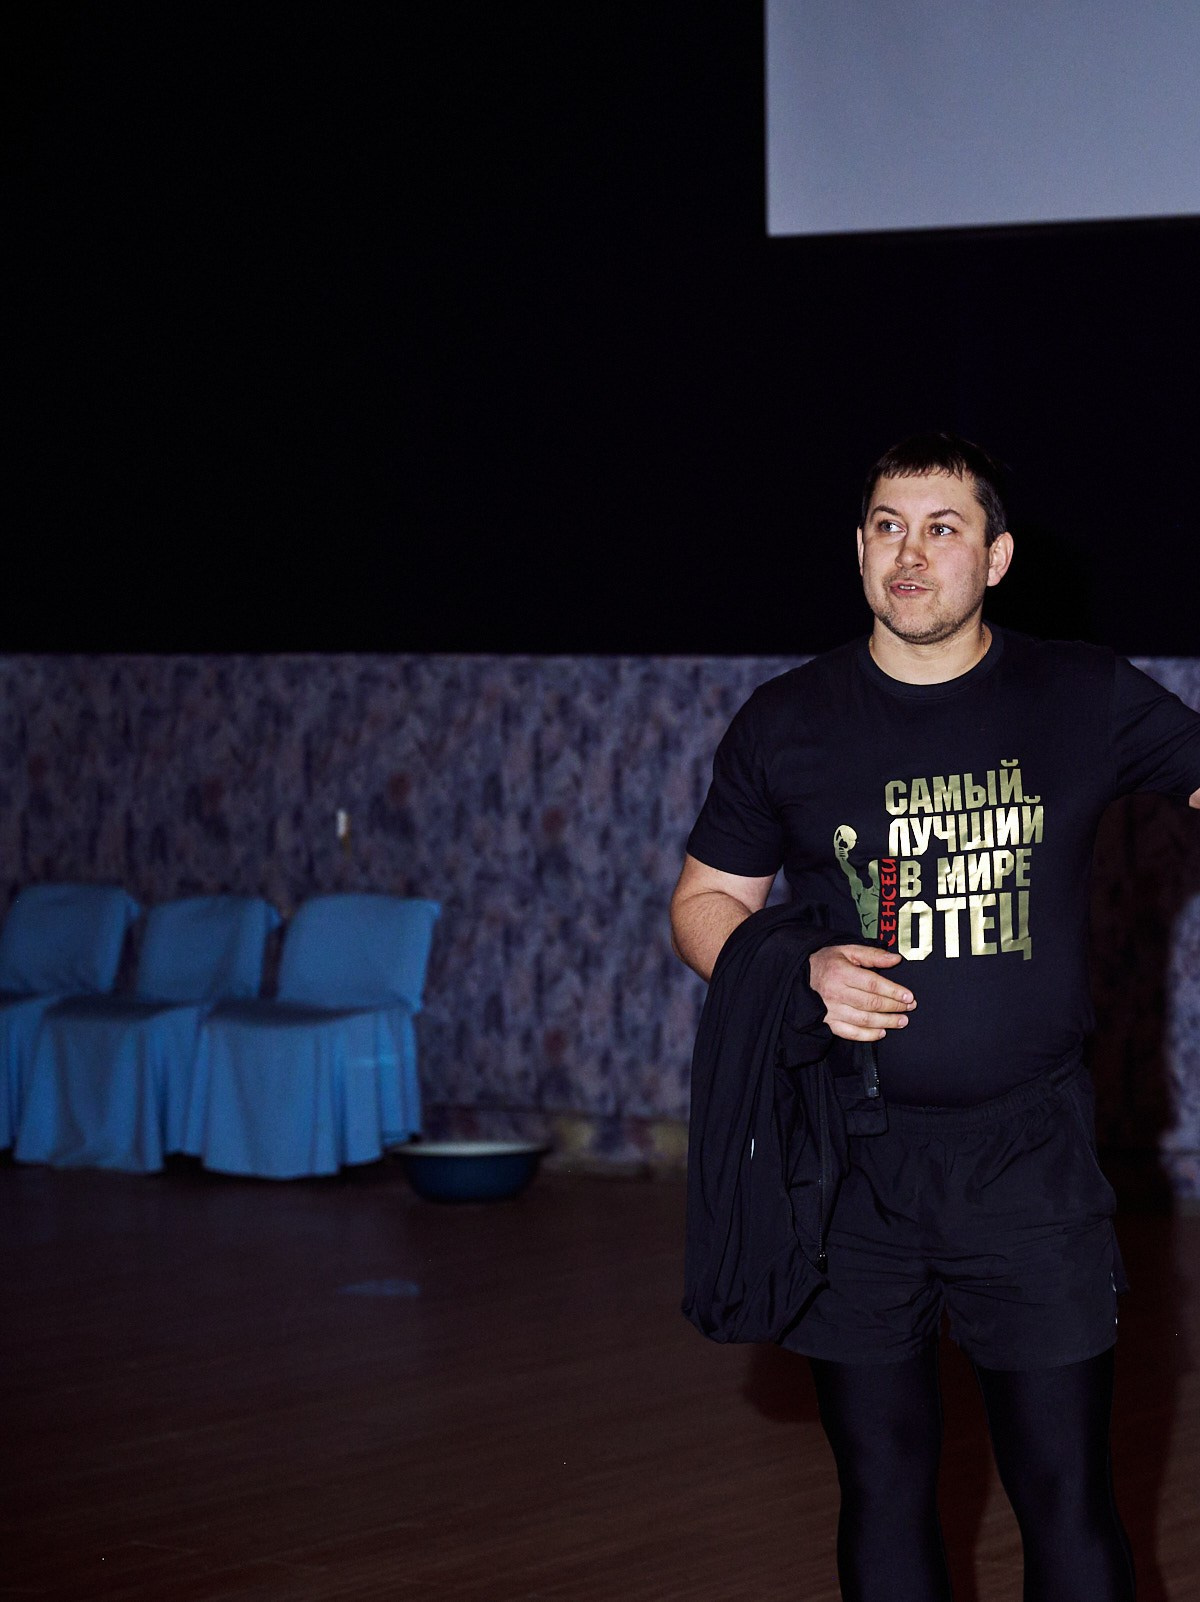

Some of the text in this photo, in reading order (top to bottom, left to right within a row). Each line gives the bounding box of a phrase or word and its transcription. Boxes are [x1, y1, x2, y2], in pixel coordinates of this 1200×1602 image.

[885, 759, 1023, 816] САМЫЙ
[888, 795, 1044, 857] ЛУЧШИЙ
[900, 848, 1032, 897] В МИРЕ
[898, 890, 1033, 961] ОТЕЦ
